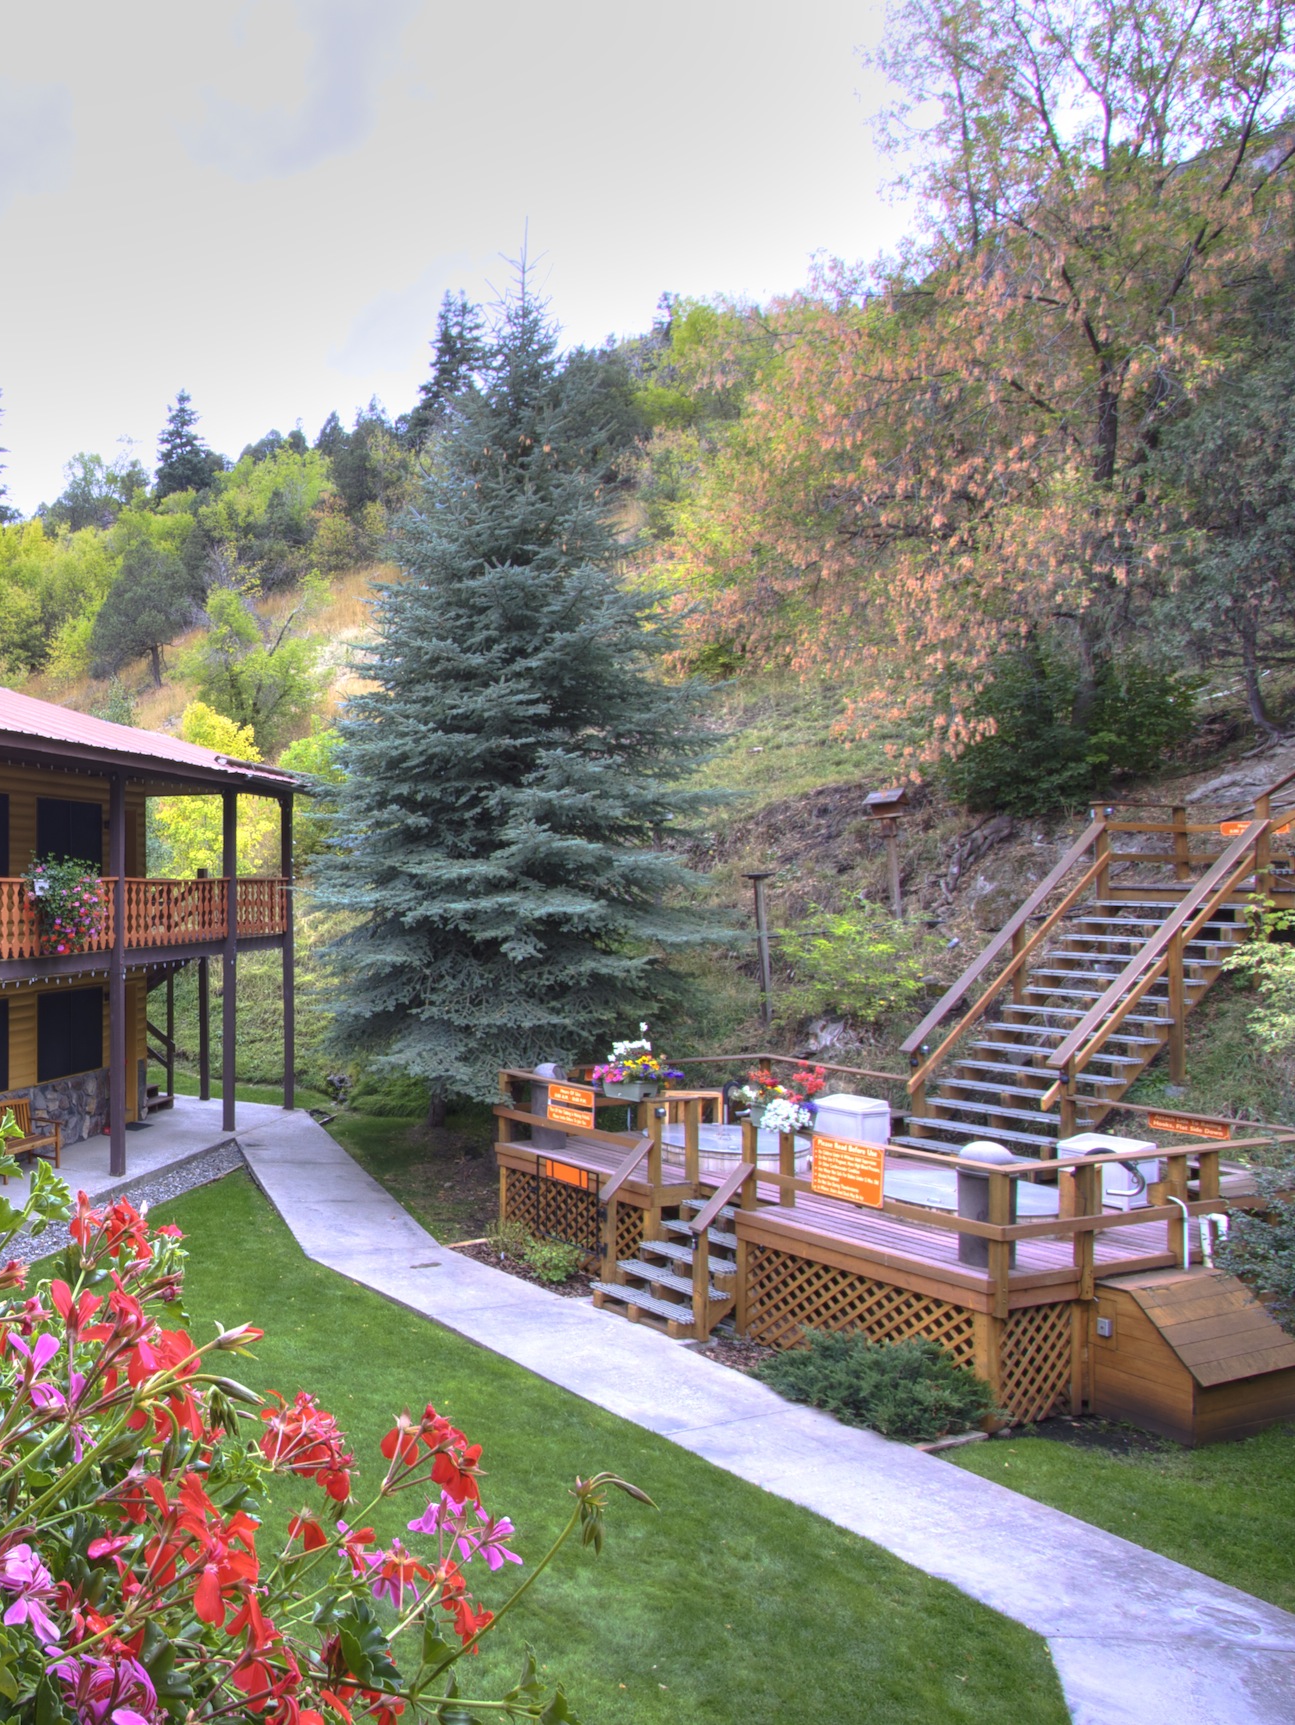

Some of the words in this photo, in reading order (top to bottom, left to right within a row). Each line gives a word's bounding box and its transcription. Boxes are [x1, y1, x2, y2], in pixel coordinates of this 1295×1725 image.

[1176, 1123, 1189, 1131] Flat
[1205, 1128, 1223, 1136] Down
[817, 1138, 833, 1148] Please
[834, 1142, 847, 1151] Read
[848, 1145, 866, 1155] Before
[867, 1148, 878, 1157] Use
